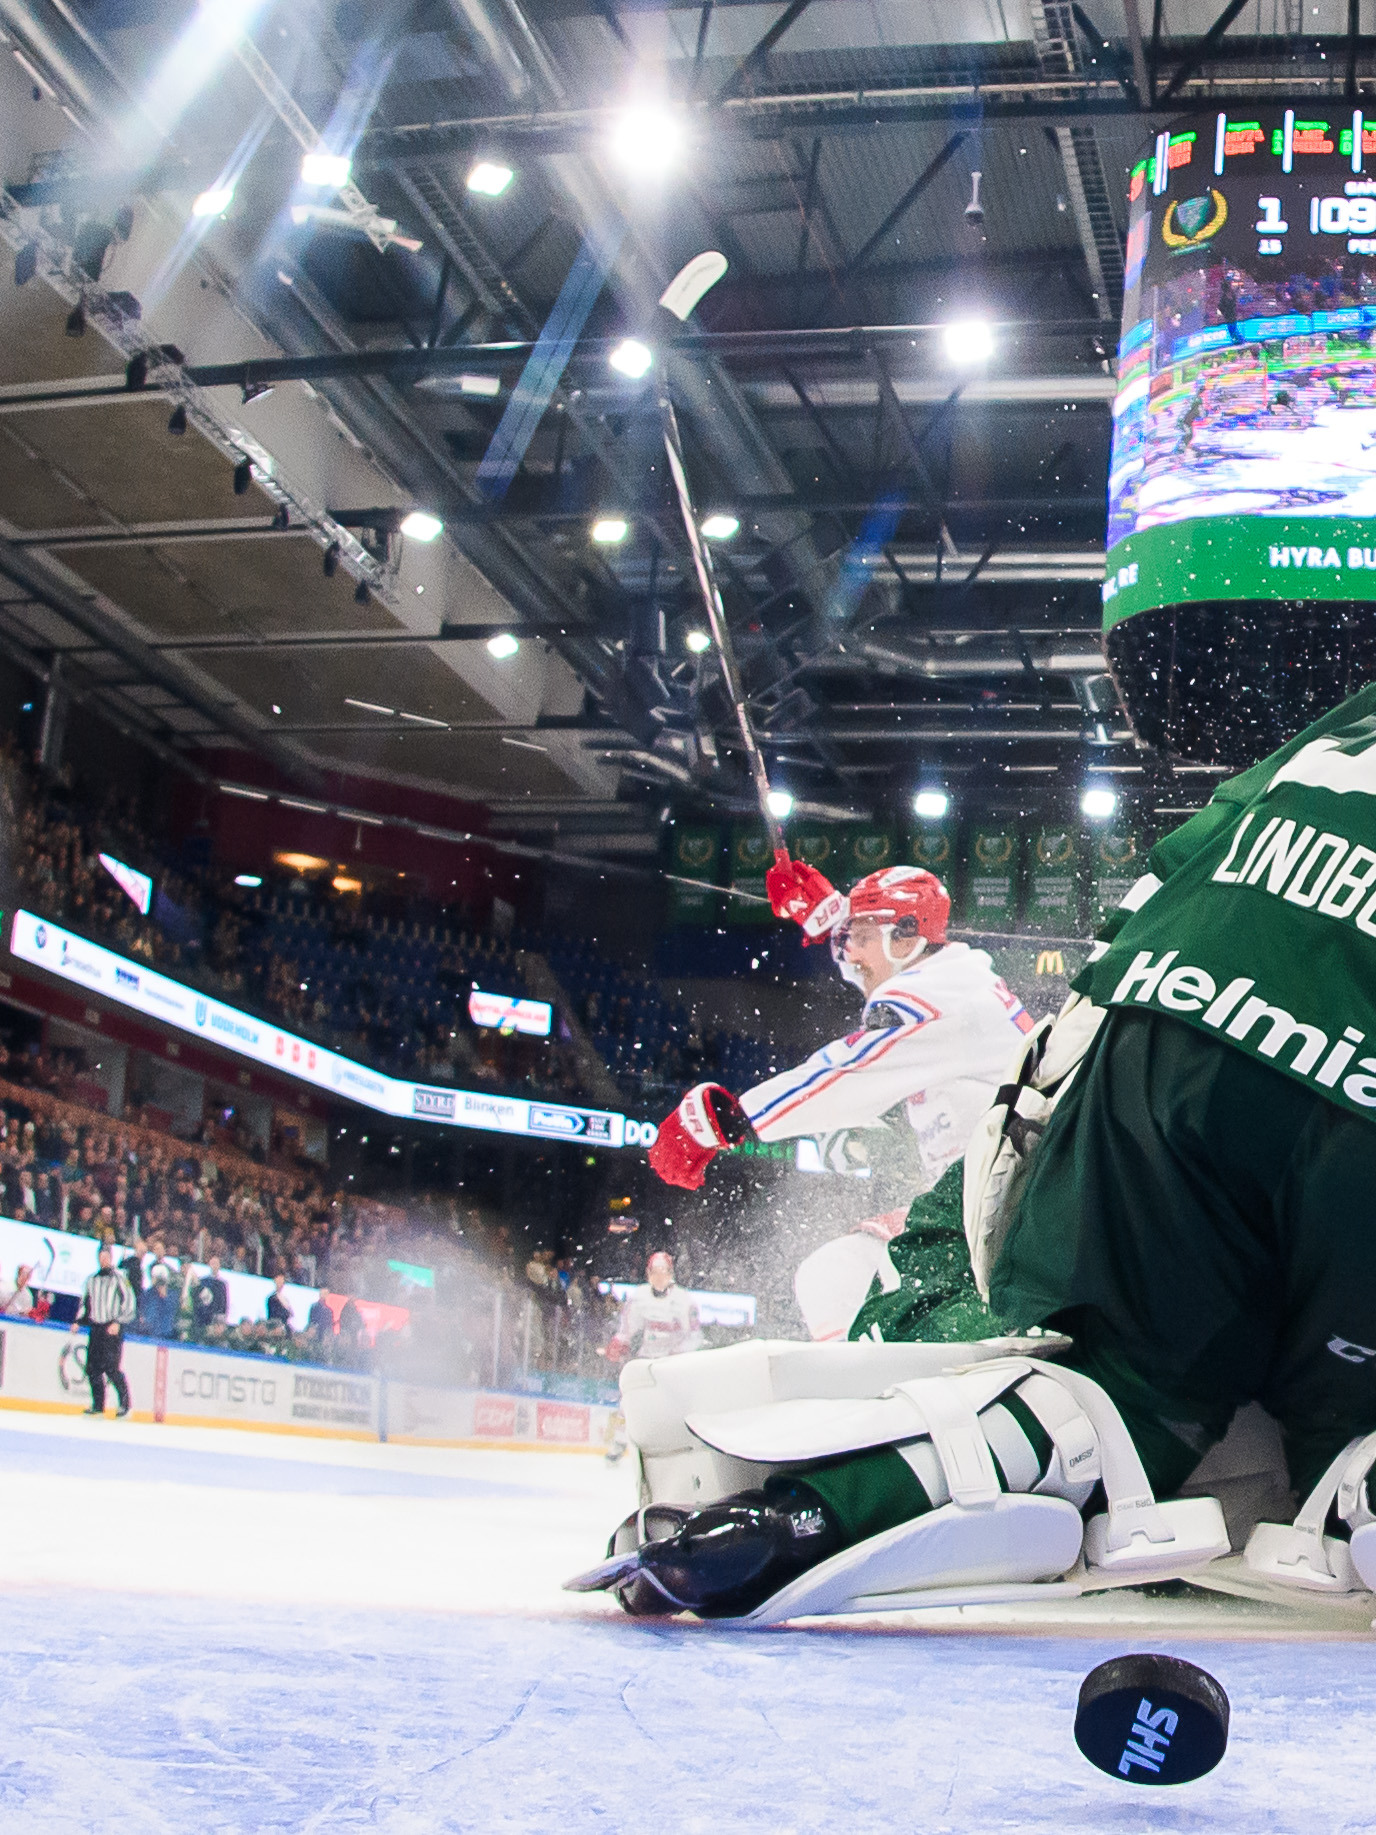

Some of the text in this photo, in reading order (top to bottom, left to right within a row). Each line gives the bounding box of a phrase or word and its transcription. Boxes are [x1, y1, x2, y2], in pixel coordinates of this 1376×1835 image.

[1256, 197, 1288, 234] 1
[1269, 546, 1341, 568] HYRA
[465, 1096, 514, 1117] Blinken
[1118, 1697, 1179, 1776] SHL
